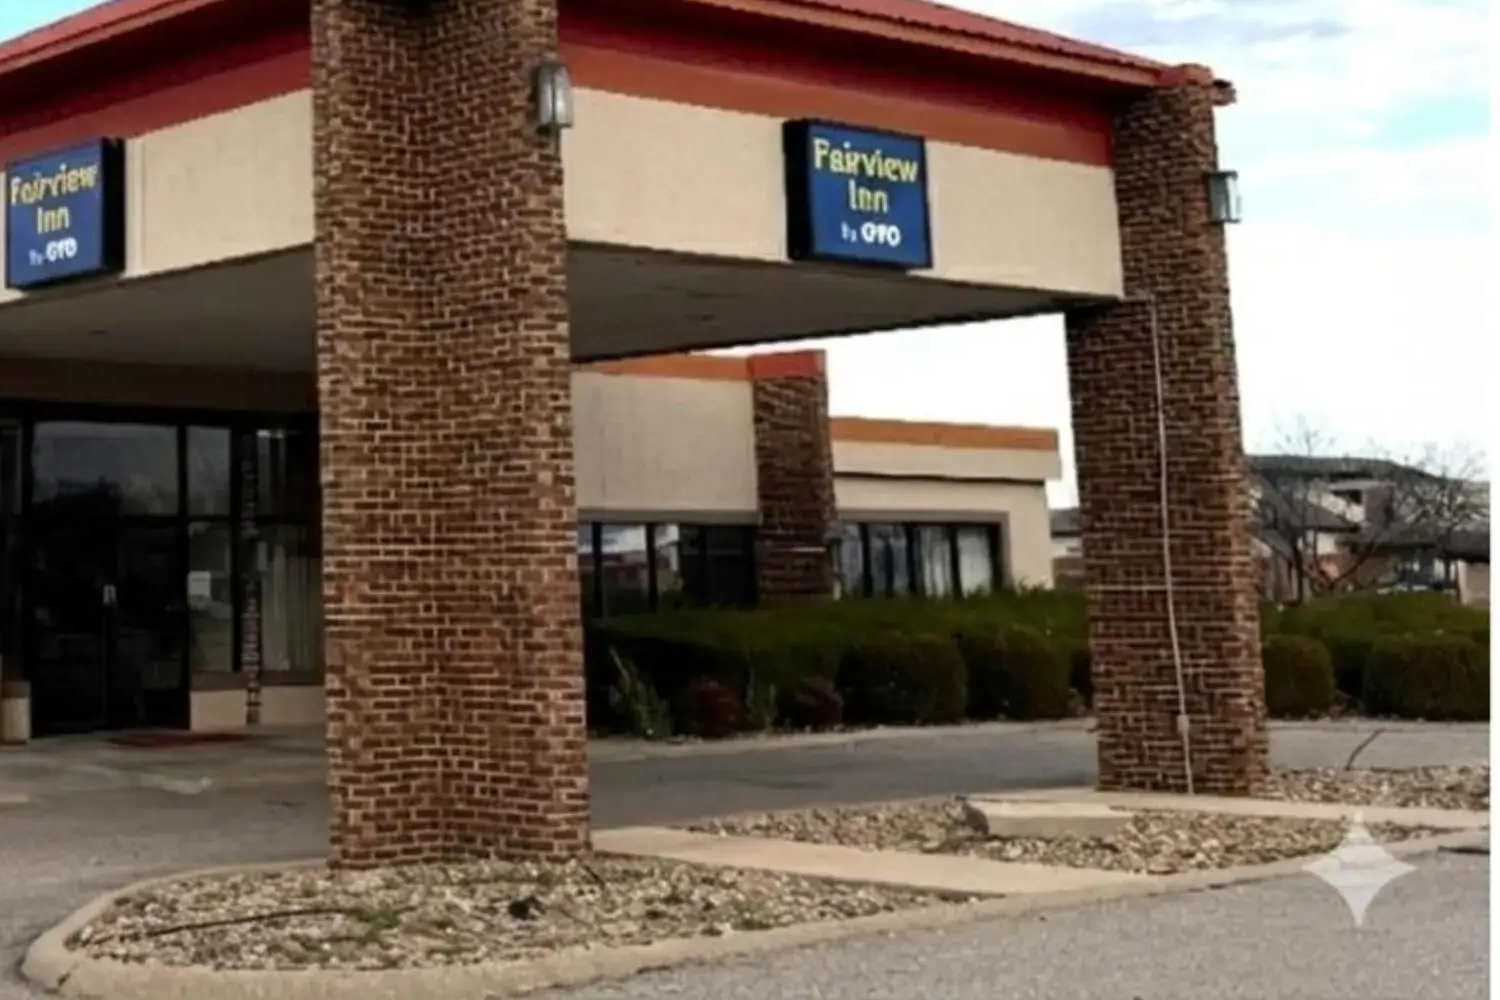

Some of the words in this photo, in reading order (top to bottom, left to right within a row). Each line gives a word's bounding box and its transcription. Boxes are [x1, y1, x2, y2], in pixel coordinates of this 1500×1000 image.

[813, 138, 918, 181] Fairview
[11, 164, 98, 205] Fairview
[848, 179, 888, 213] Inn
[37, 207, 69, 233] Inn
[860, 222, 901, 246] OYO
